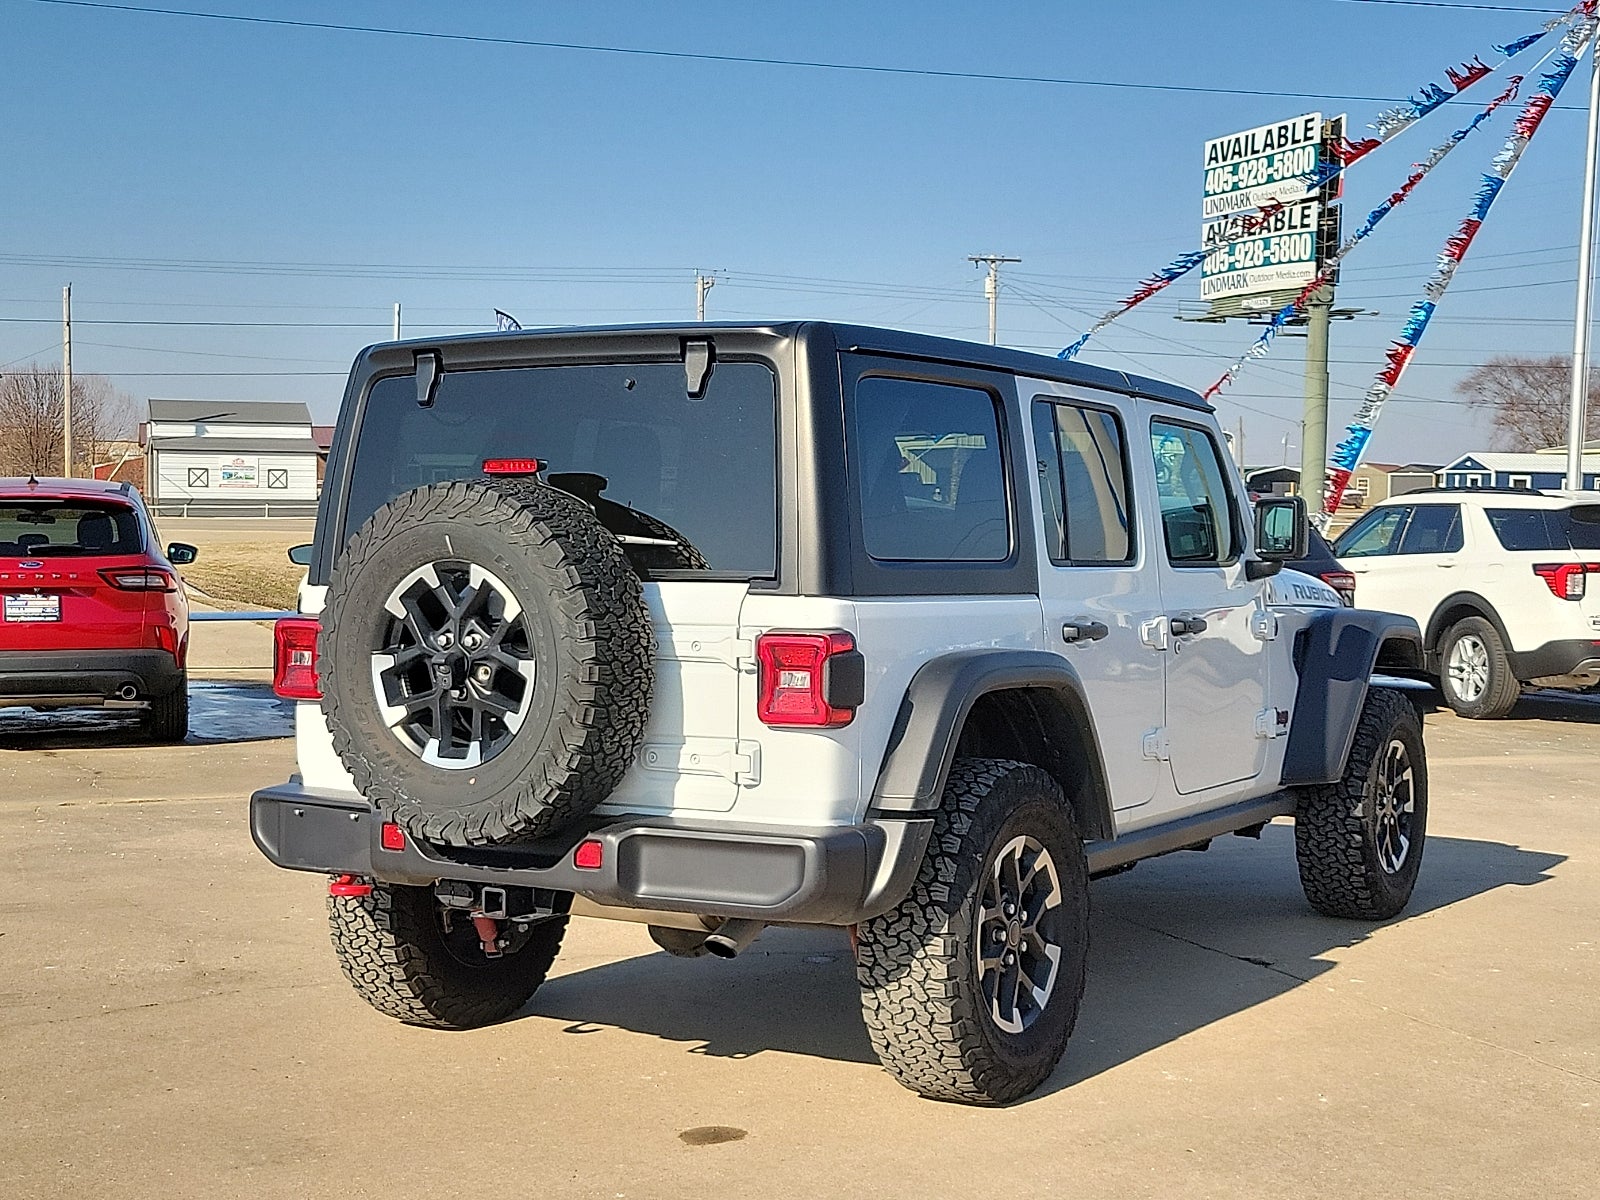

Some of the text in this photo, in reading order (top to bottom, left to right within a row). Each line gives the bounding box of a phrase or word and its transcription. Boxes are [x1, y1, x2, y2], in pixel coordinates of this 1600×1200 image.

[1207, 117, 1315, 166] AVAILABLE
[1204, 145, 1315, 195] 405-928-5800
[1205, 191, 1251, 215] LINDMARK
[1279, 183, 1306, 196] Media.c
[1206, 205, 1312, 246] AVABLE
[1202, 233, 1312, 276] 405-928-5800
[1202, 273, 1249, 296] LINDMARK
[1292, 583, 1342, 604] RUBICO
